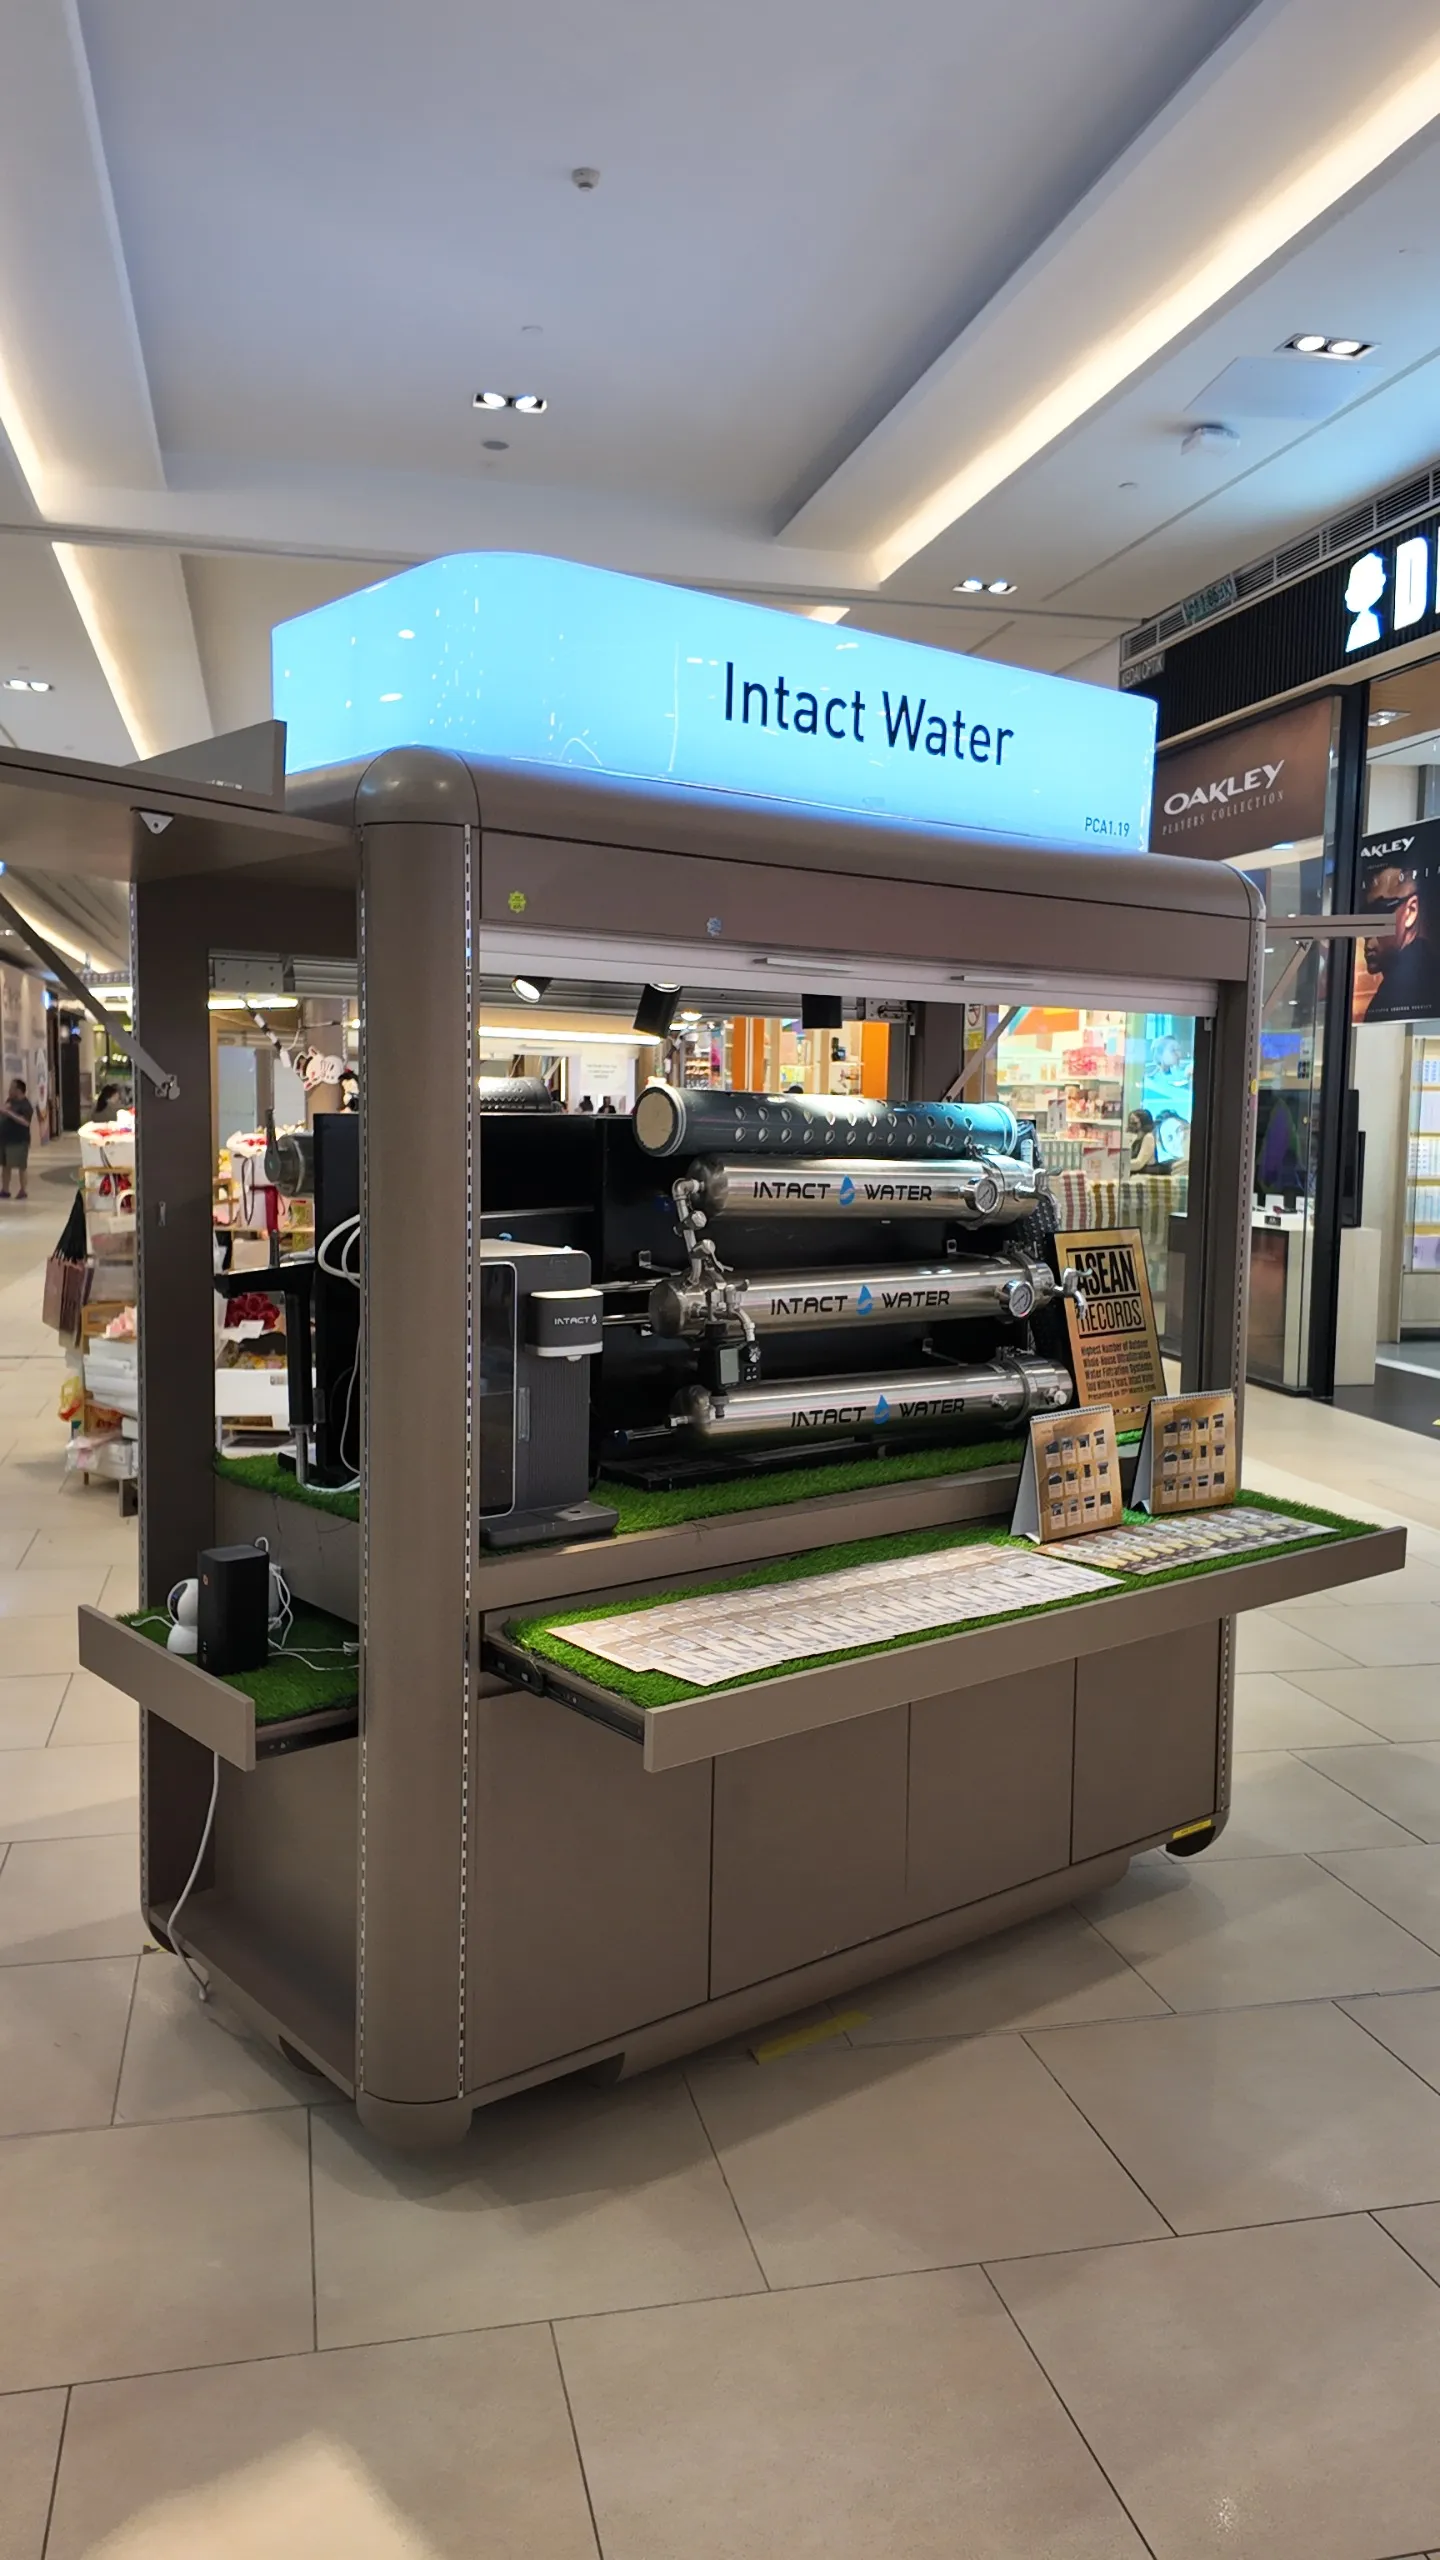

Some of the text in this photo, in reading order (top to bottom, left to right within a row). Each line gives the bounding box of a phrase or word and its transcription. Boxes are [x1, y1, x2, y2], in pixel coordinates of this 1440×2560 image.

[1394, 526, 1440, 630] D
[725, 661, 1015, 766] Intact Water
[1163, 759, 1285, 815] OAKLEY
[1084, 816, 1130, 838] PCA1.19
[1162, 790, 1284, 836] PLAYERS COLLECTION
[1360, 836, 1416, 858] AKLEY
[753, 1181, 933, 1201] INTACT WATER
[1074, 1250, 1137, 1296] ASEAN
[770, 1290, 950, 1316] INTACT WATER
[554, 1316, 590, 1325] INTACT
[791, 1398, 965, 1428] INTACT WATER
